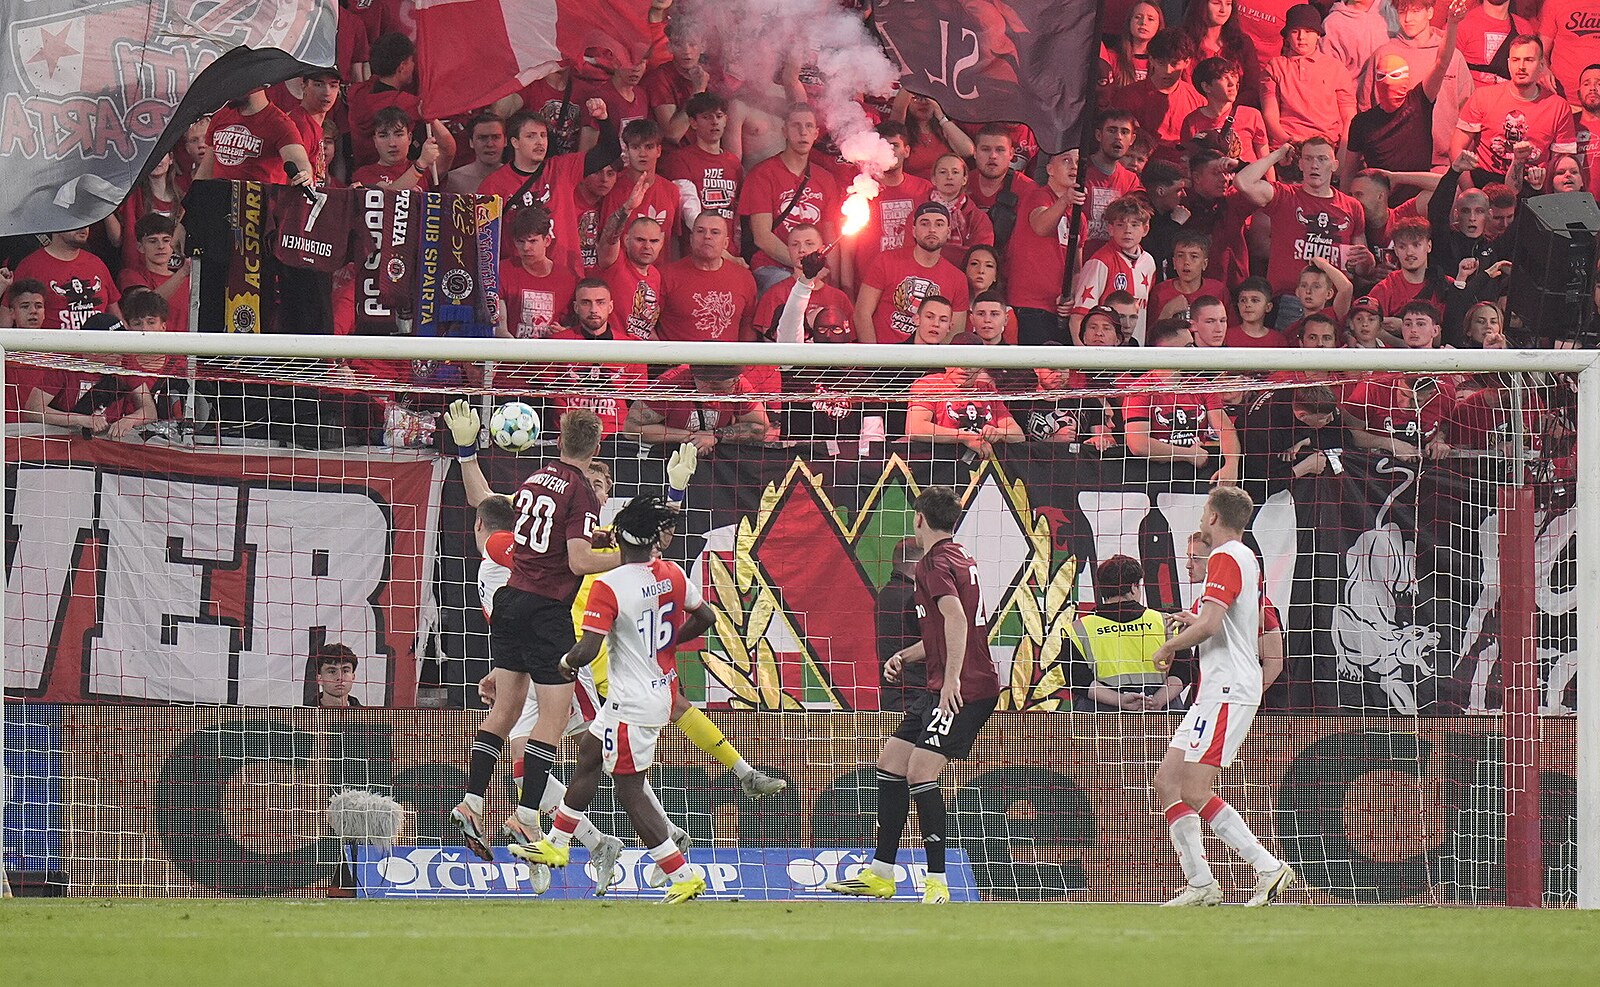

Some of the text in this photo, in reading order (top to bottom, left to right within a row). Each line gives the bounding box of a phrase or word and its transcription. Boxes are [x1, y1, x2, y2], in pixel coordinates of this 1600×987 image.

[281, 234, 333, 257] SOLBAKKEN
[420, 192, 442, 325] CLUB SPARTA
[245, 257, 260, 290] AC
[514, 489, 556, 554] 20
[641, 580, 673, 598] MOSES
[636, 602, 675, 658] 16
[1097, 623, 1153, 635] SECURITY
[926, 707, 954, 736] 29
[1193, 716, 1207, 738] 4
